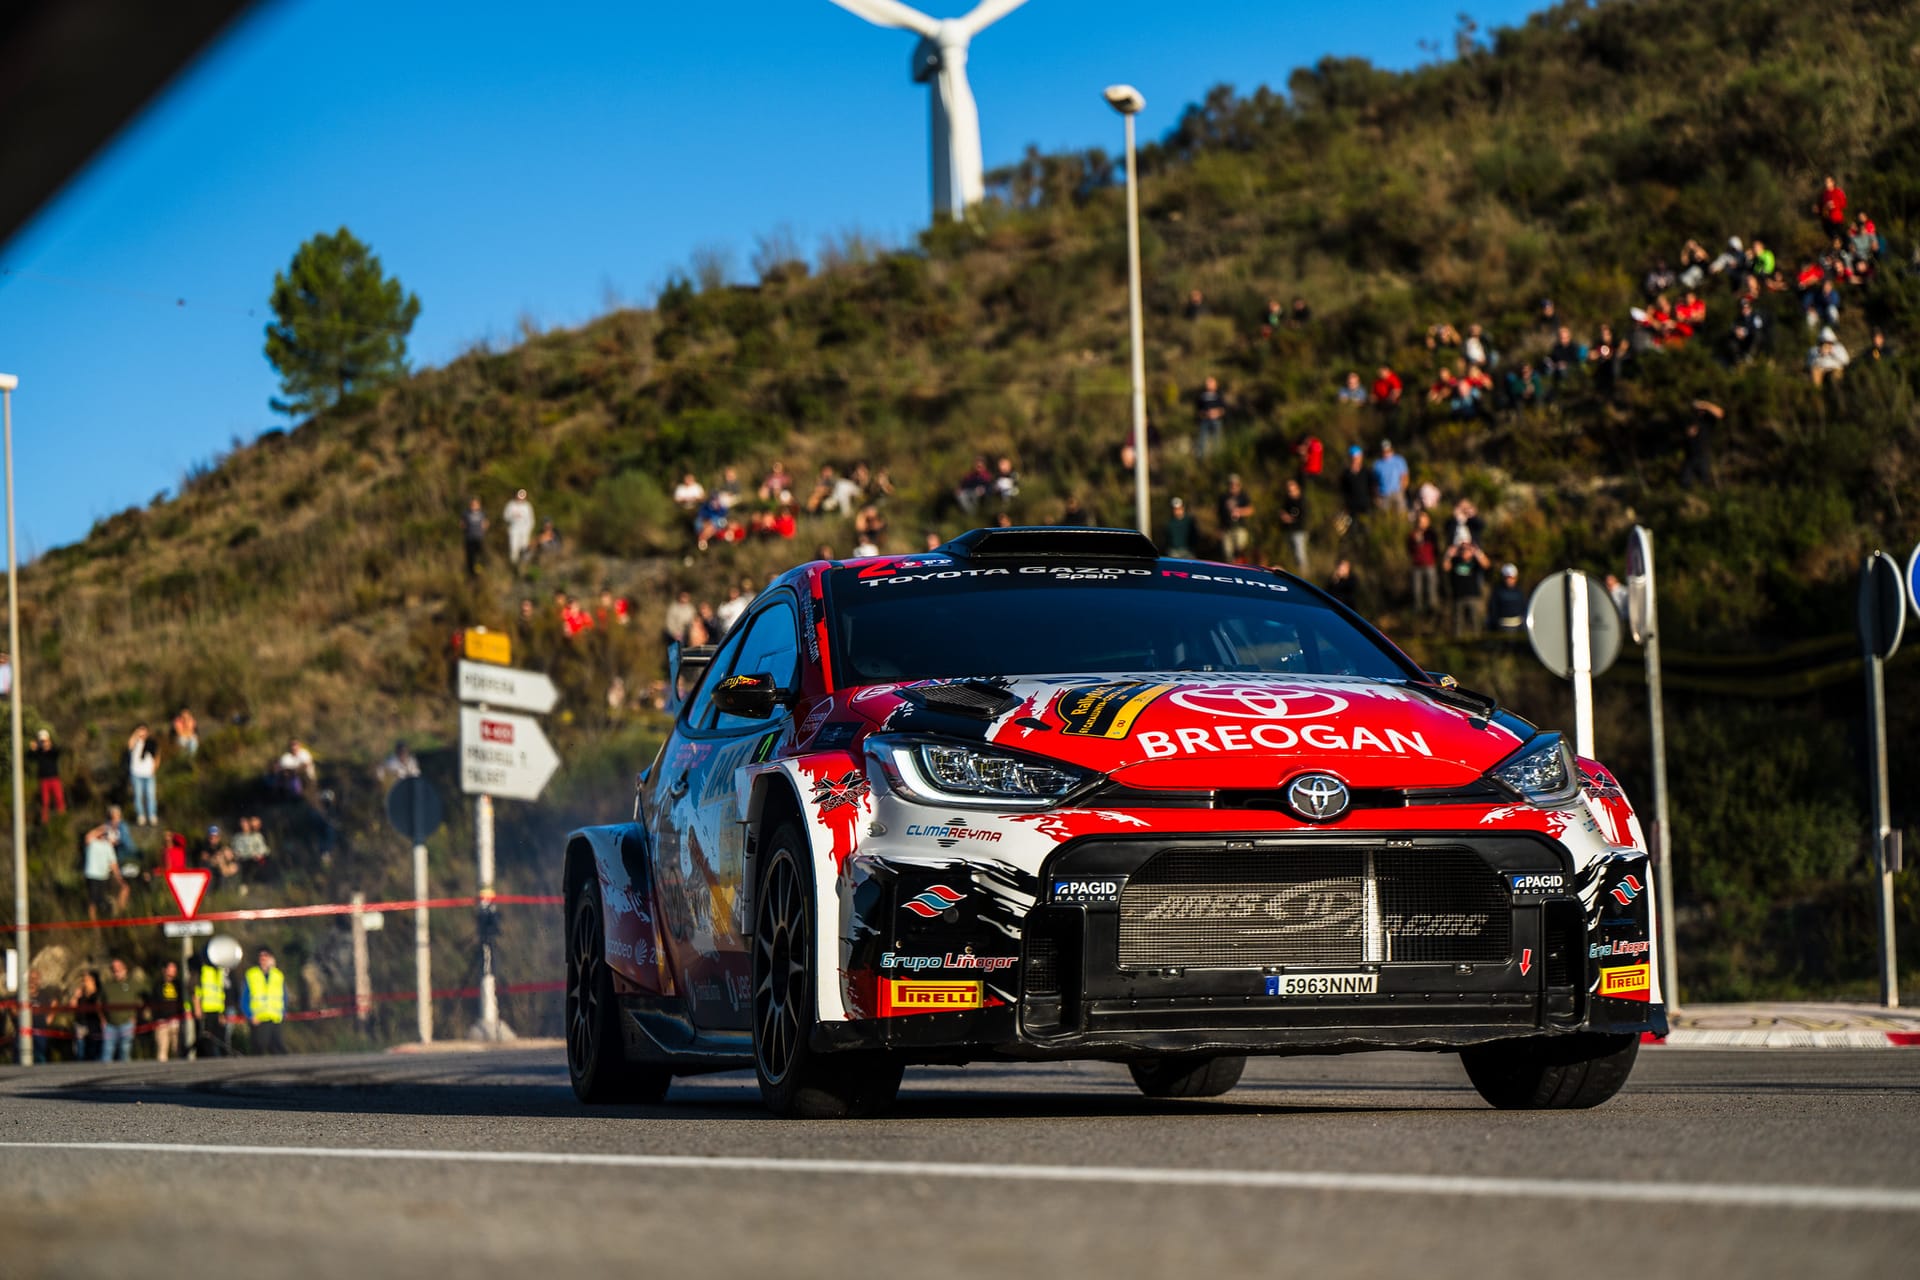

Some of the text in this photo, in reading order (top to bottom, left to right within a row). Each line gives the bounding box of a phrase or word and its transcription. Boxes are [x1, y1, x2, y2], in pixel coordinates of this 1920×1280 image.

[860, 566, 1289, 592] TOYOTA GAZOO Racing
[1136, 724, 1434, 759] BREOGAN
[906, 825, 1003, 842] CLIMAREYMA
[1070, 882, 1117, 895] PAGID
[1526, 875, 1563, 887] PAGID
[880, 952, 1019, 972] Grupo Liñagar
[1286, 978, 1374, 994] 5963NNM
[1607, 969, 1645, 989] PIRELLI
[897, 985, 977, 1002] PIRELLI
